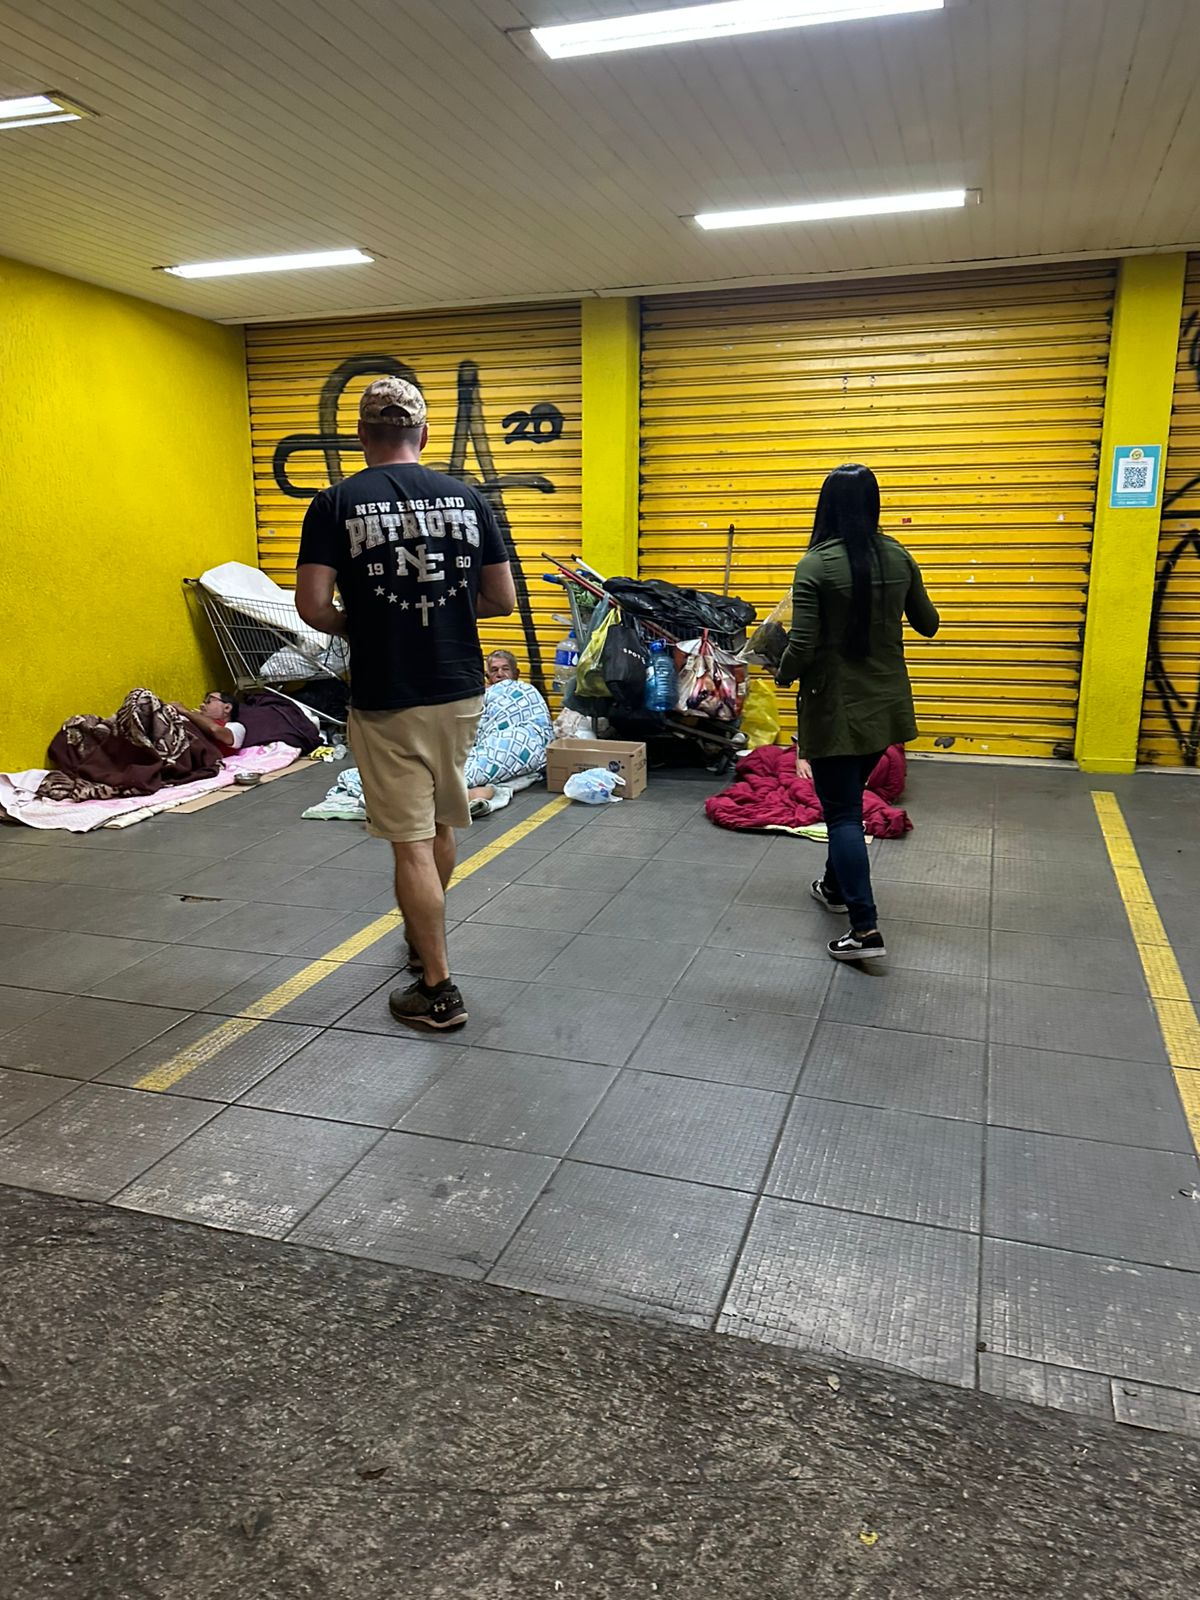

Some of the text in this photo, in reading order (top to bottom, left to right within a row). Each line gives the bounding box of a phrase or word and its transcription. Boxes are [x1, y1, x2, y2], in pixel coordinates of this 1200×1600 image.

[502, 403, 564, 444] 20
[355, 496, 465, 516] NEW ENGLAND
[345, 509, 480, 558] PATRIOTS
[366, 543, 471, 582] 19 NE 60
